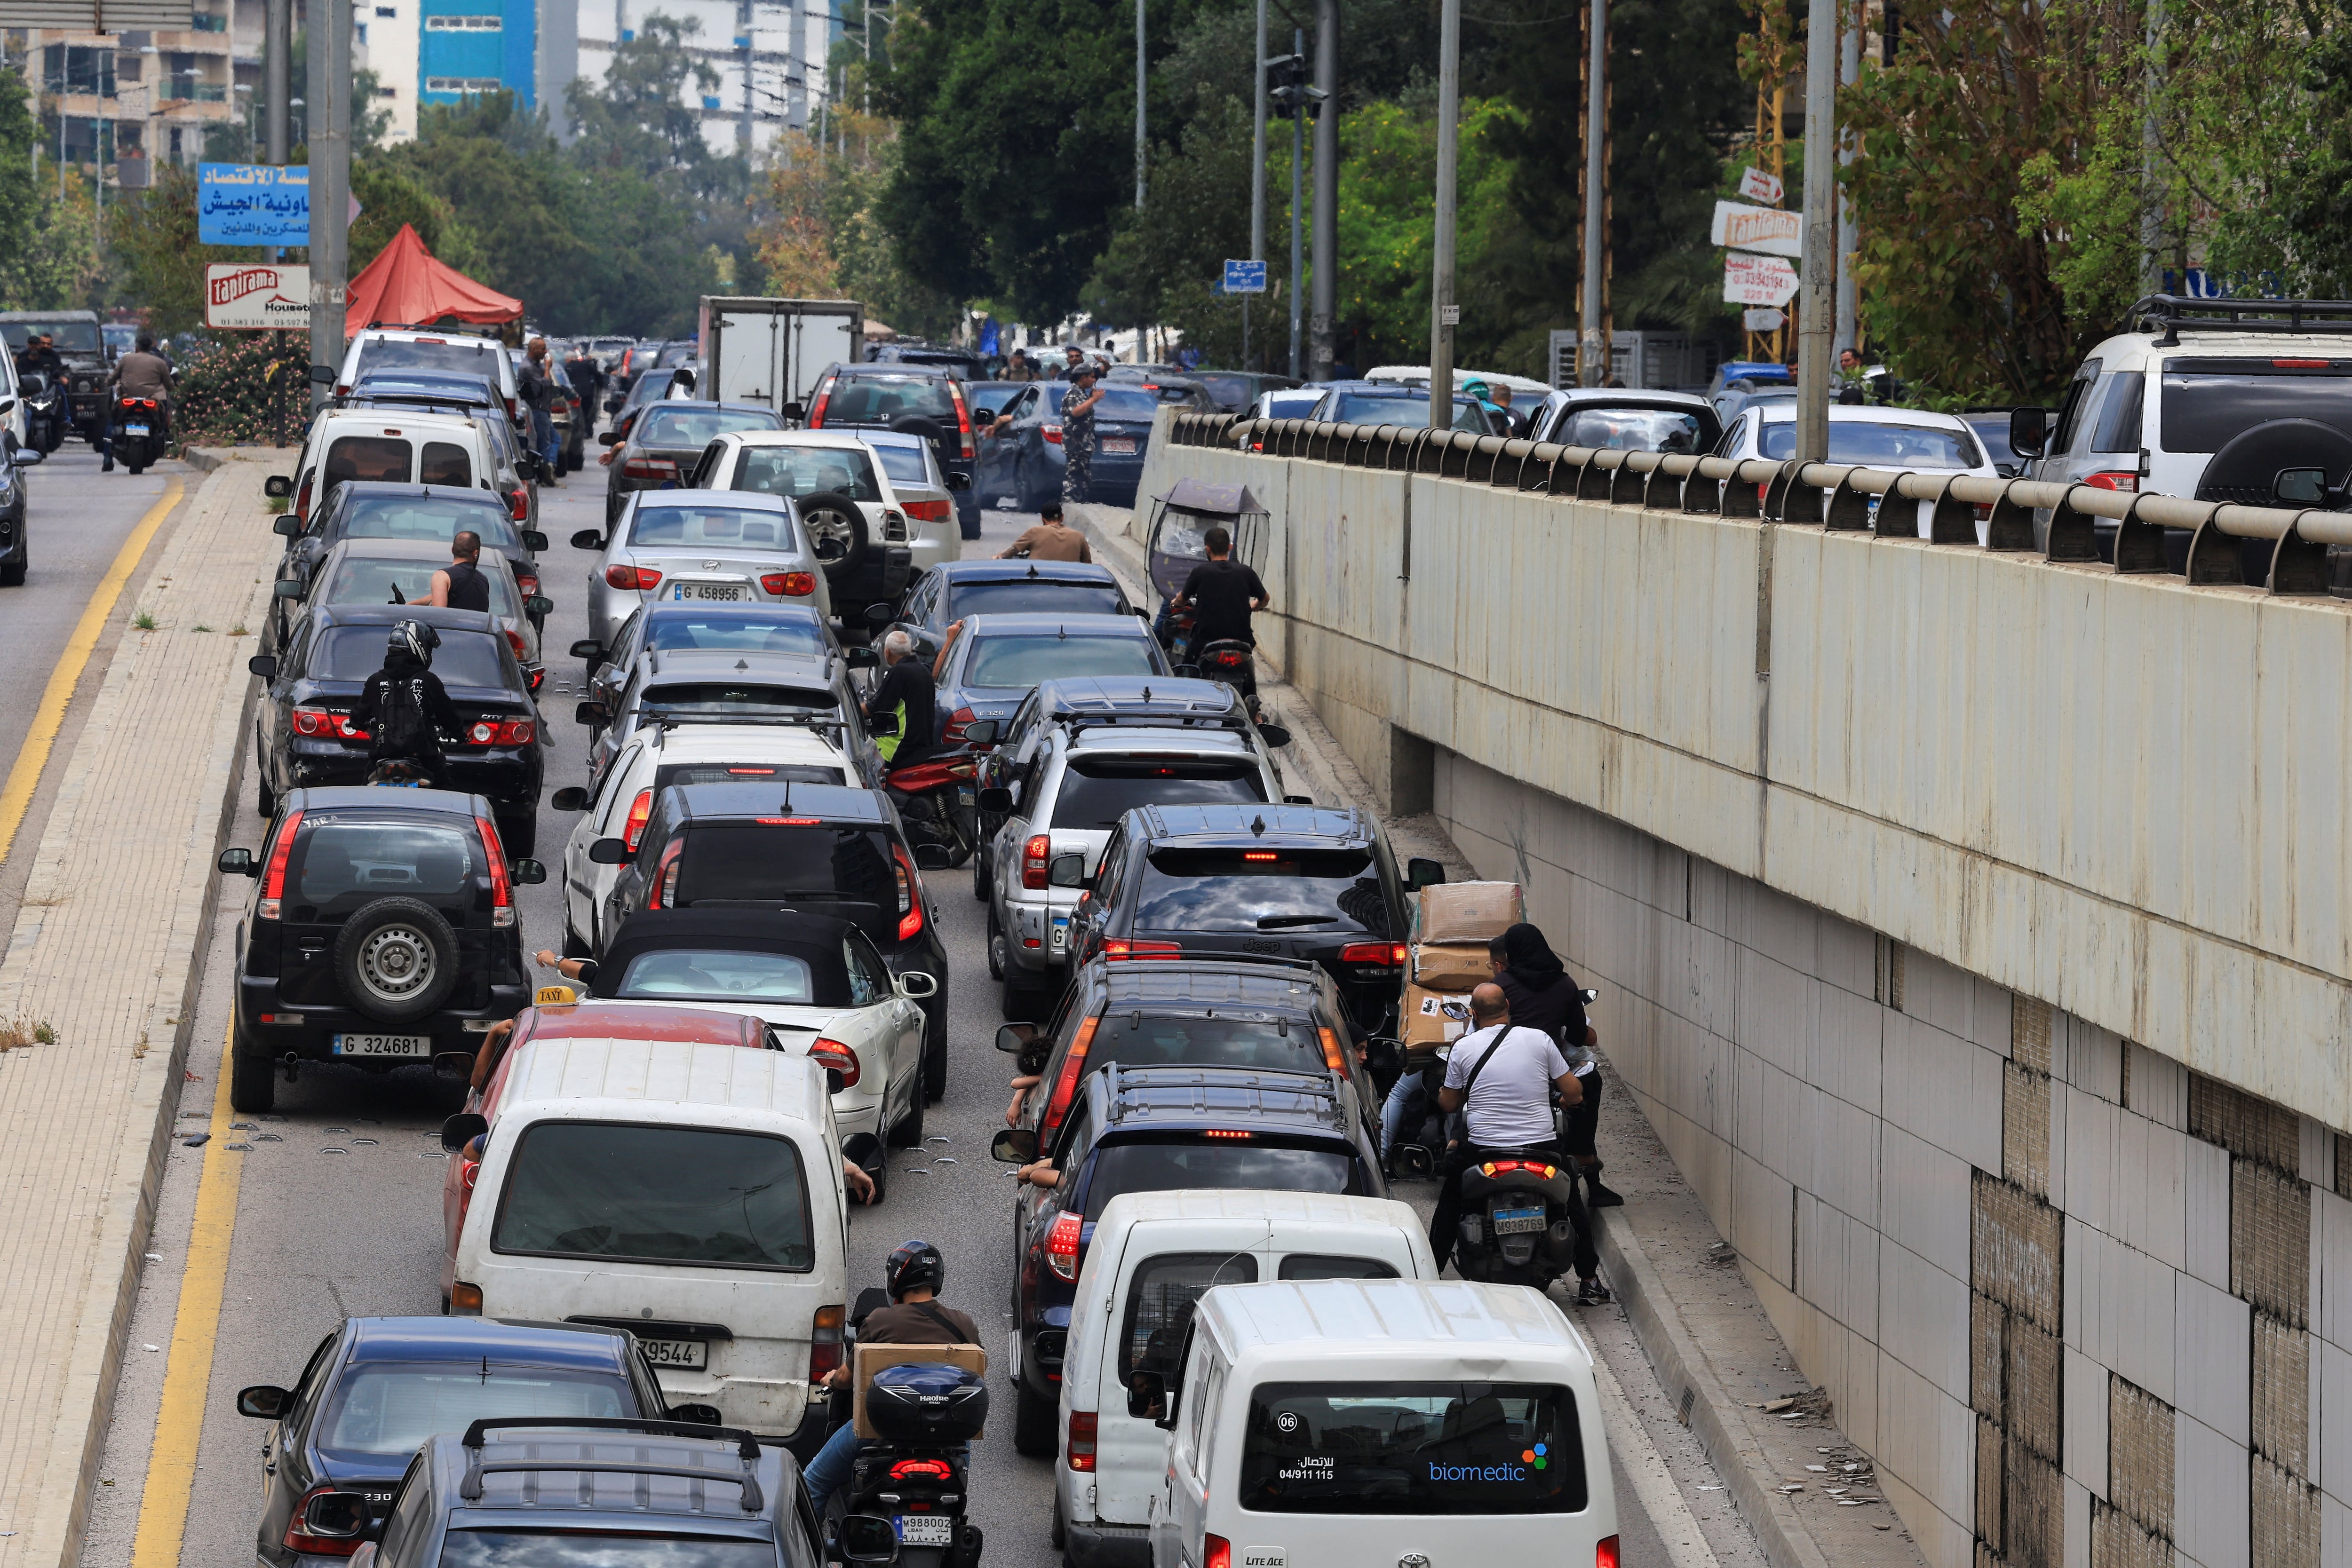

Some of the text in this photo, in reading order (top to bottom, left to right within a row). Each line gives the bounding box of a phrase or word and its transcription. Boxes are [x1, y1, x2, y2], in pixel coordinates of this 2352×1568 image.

[203, 190, 259, 215] الجيش
[222, 221, 260, 236] والمدنيين
[214, 269, 276, 303] tapirama
[684, 586, 739, 601] G 458956
[1243, 938, 1281, 954] Jeep
[540, 991, 561, 1001] TAXI
[345, 1037, 418, 1054] G 324681
[1497, 1218, 1544, 1232] M938769
[1281, 1417, 1294, 1427] 06
[1279, 1469, 1333, 1479] 04/911 115
[1429, 1462, 1525, 1481] biomedic
[903, 1518, 951, 1528] M988002
[1246, 1557, 1284, 1566] LITE ACE
